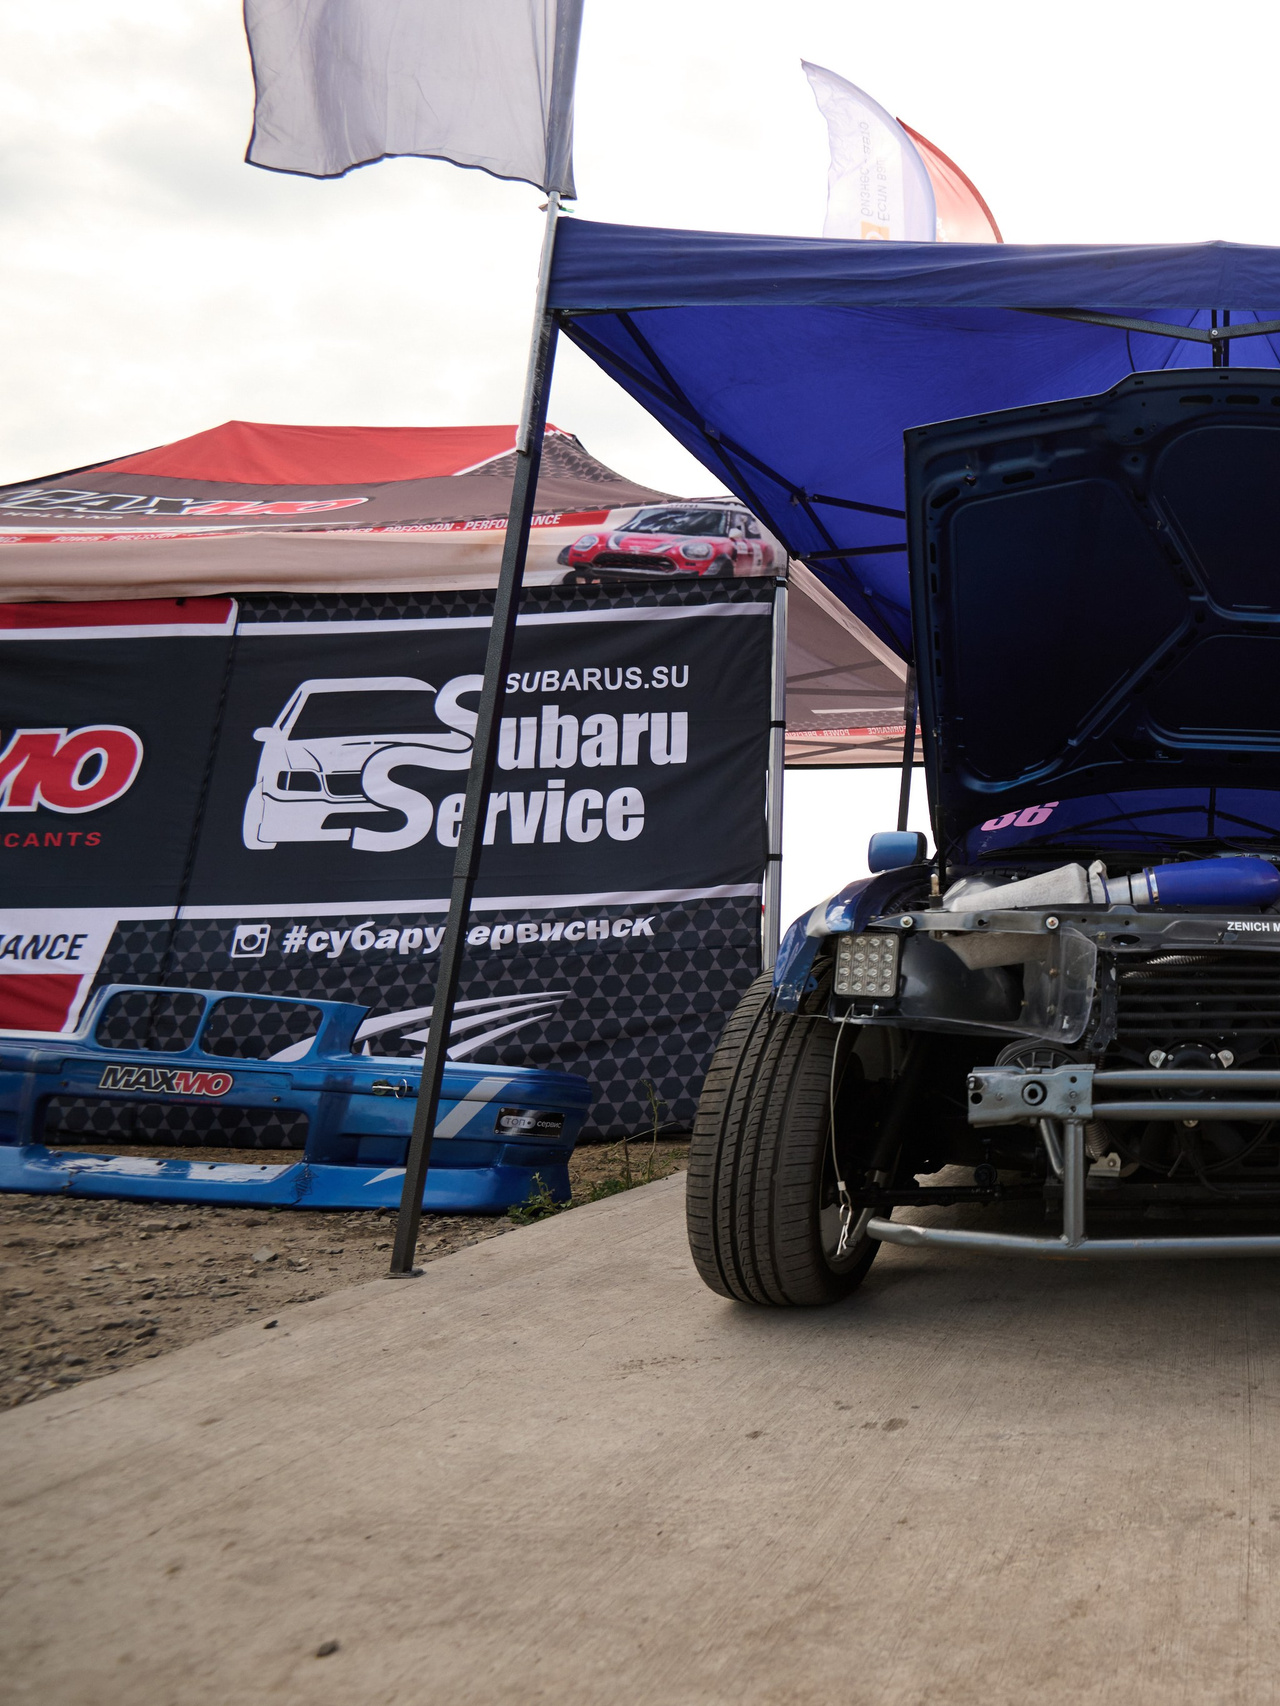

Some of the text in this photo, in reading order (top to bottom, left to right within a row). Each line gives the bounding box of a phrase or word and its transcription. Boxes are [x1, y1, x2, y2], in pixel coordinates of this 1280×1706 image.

[464, 513, 562, 530] PERFOANCE
[505, 665, 689, 694] SUBARUS.SU
[352, 746, 645, 852] Service
[283, 916, 656, 959] #субаруервиснск
[1227, 921, 1270, 932] ZENICH
[0, 934, 88, 960] ANCE
[99, 1066, 233, 1097] MAXMO
